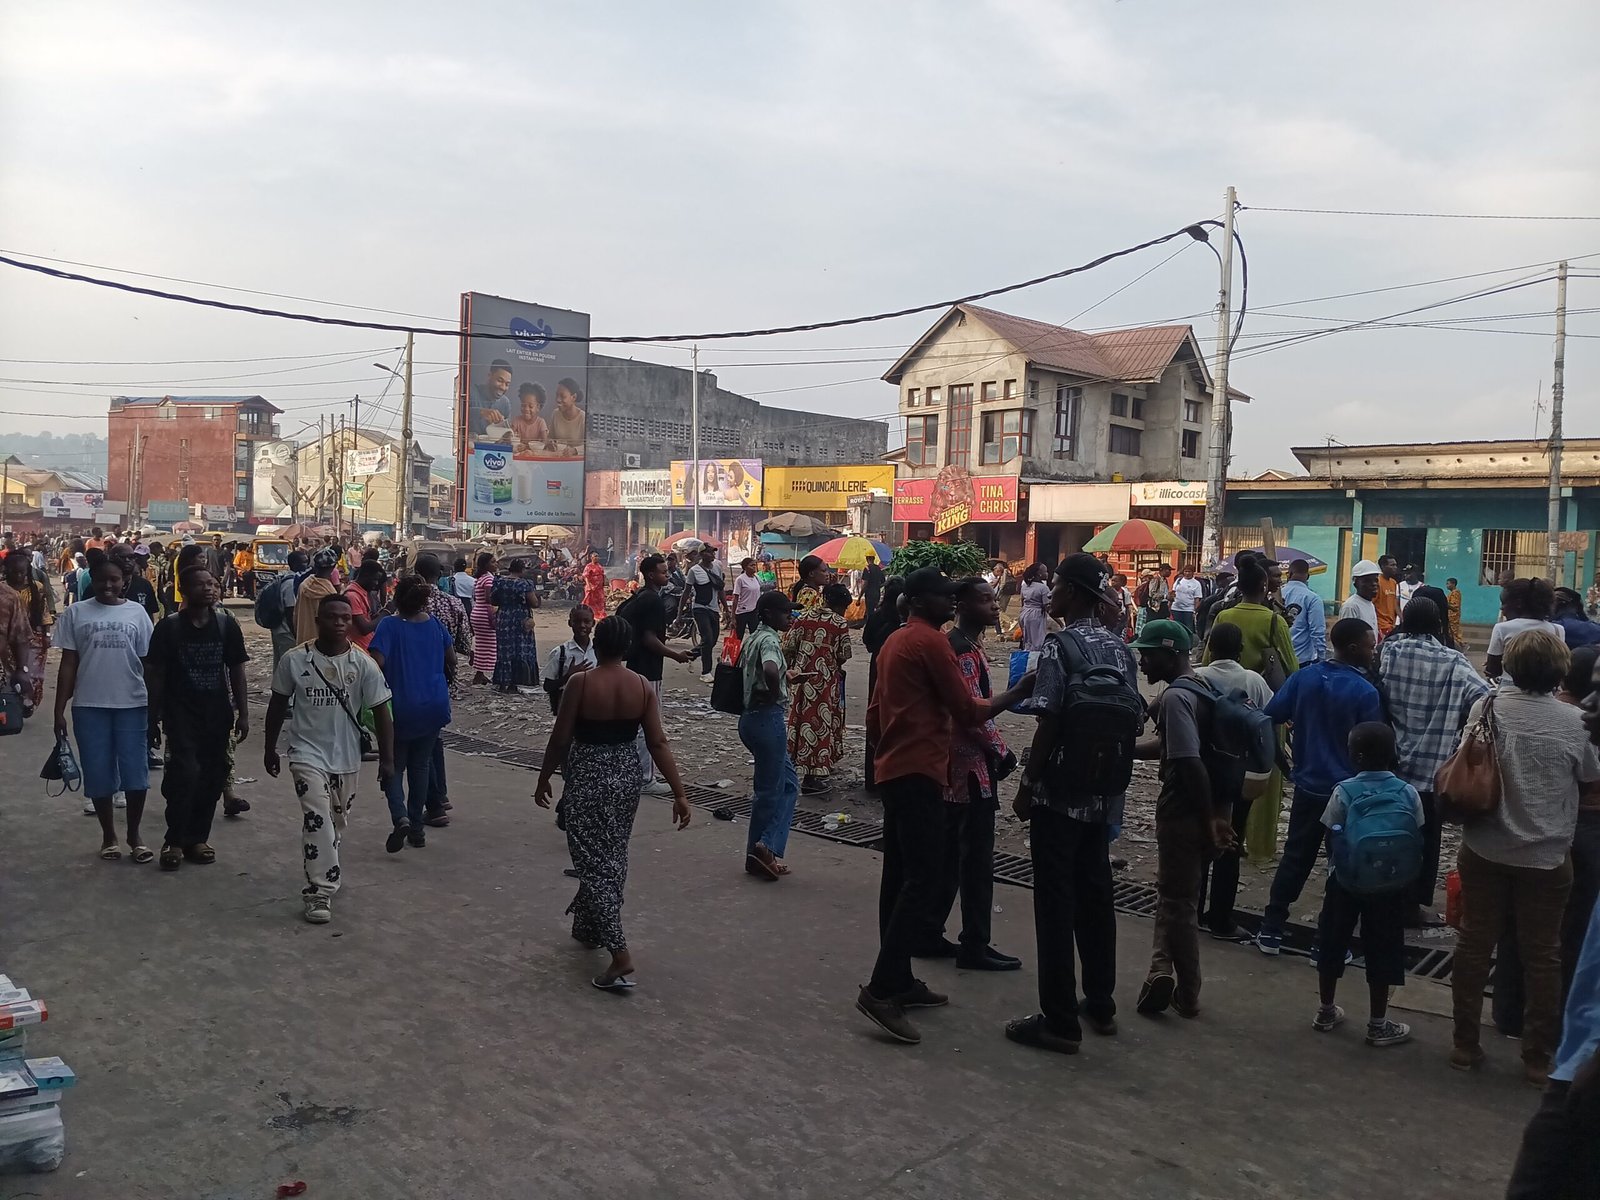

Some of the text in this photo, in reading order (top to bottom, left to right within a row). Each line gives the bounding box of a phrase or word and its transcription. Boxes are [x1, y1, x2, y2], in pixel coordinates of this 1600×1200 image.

[806, 480, 868, 493] QUINCAILLERIE
[981, 485, 1004, 498] TINA
[895, 496, 924, 505] TERRASSE
[980, 500, 1016, 513] CHRIST
[941, 503, 966, 520] TURBO
[937, 508, 969, 533] KING
[1323, 514, 1405, 526] BOIQUE
[94, 640, 127, 649] PARIS
[312, 697, 325, 706] FLY
